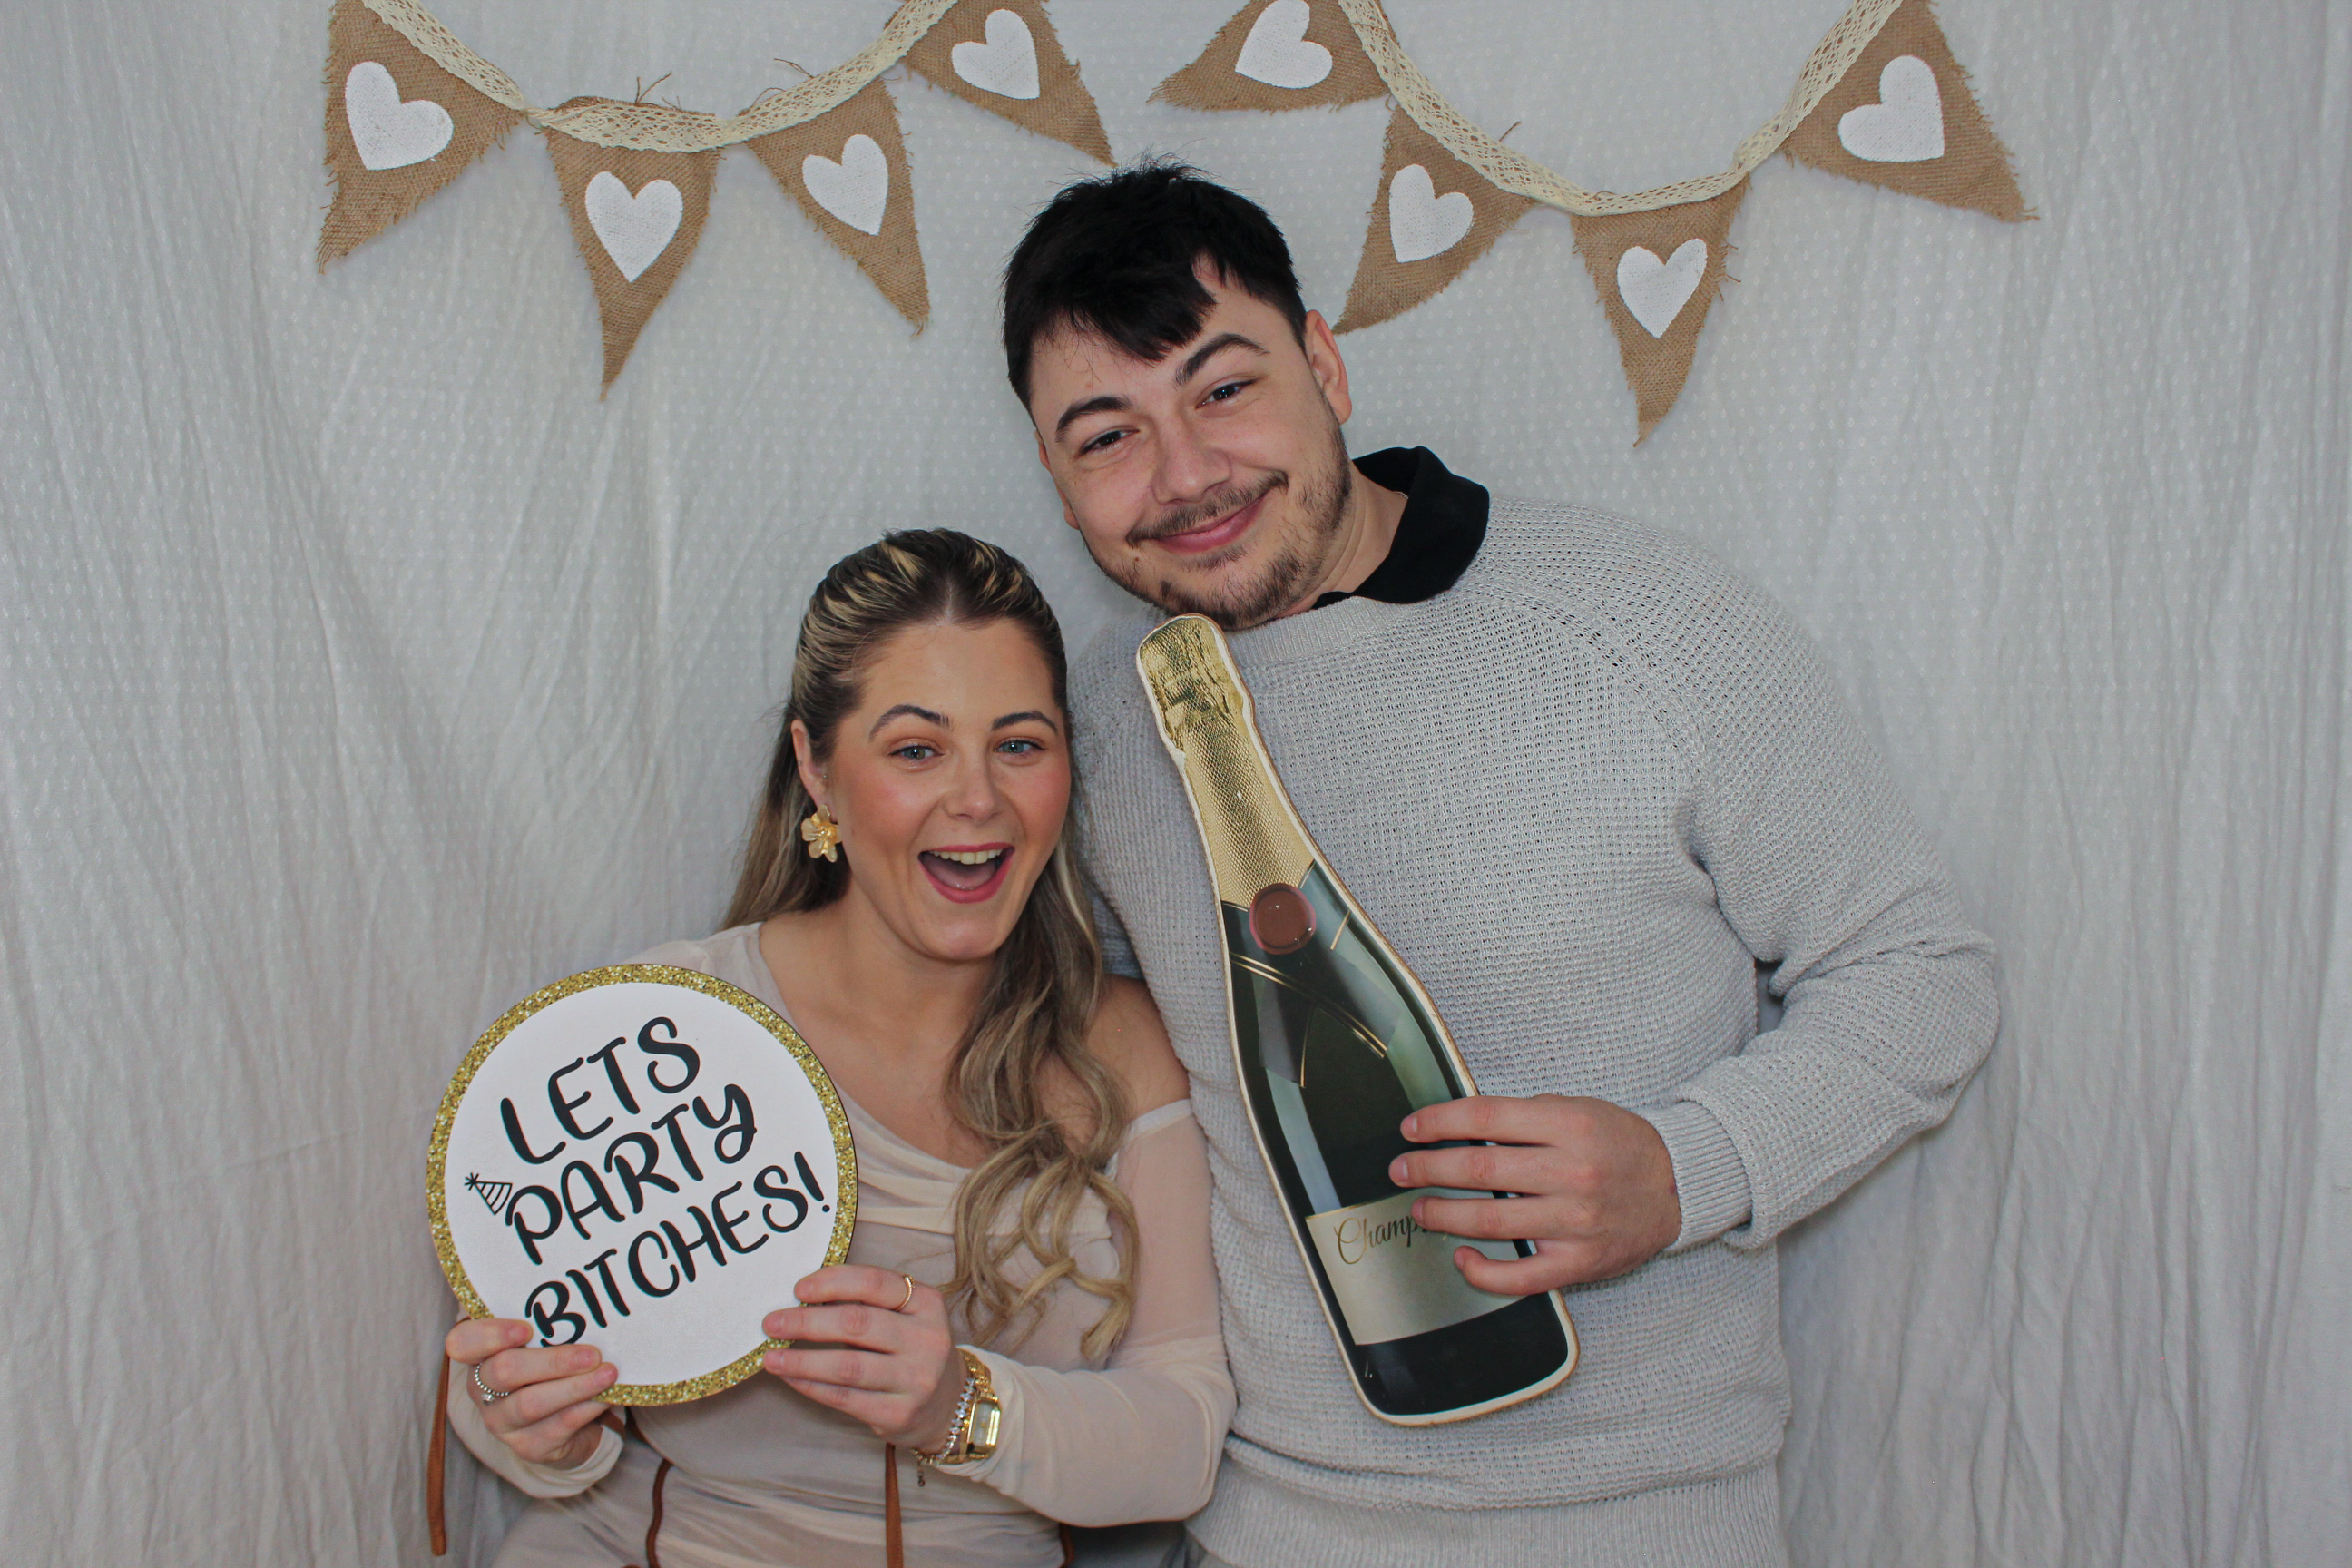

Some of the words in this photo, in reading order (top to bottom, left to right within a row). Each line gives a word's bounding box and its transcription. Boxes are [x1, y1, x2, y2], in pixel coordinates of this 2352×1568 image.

[500, 1016, 701, 1165] LETS
[505, 1083, 759, 1266] PARTY
[524, 1151, 831, 1348] BITCHES!
[1333, 1215, 1447, 1265] Champ
